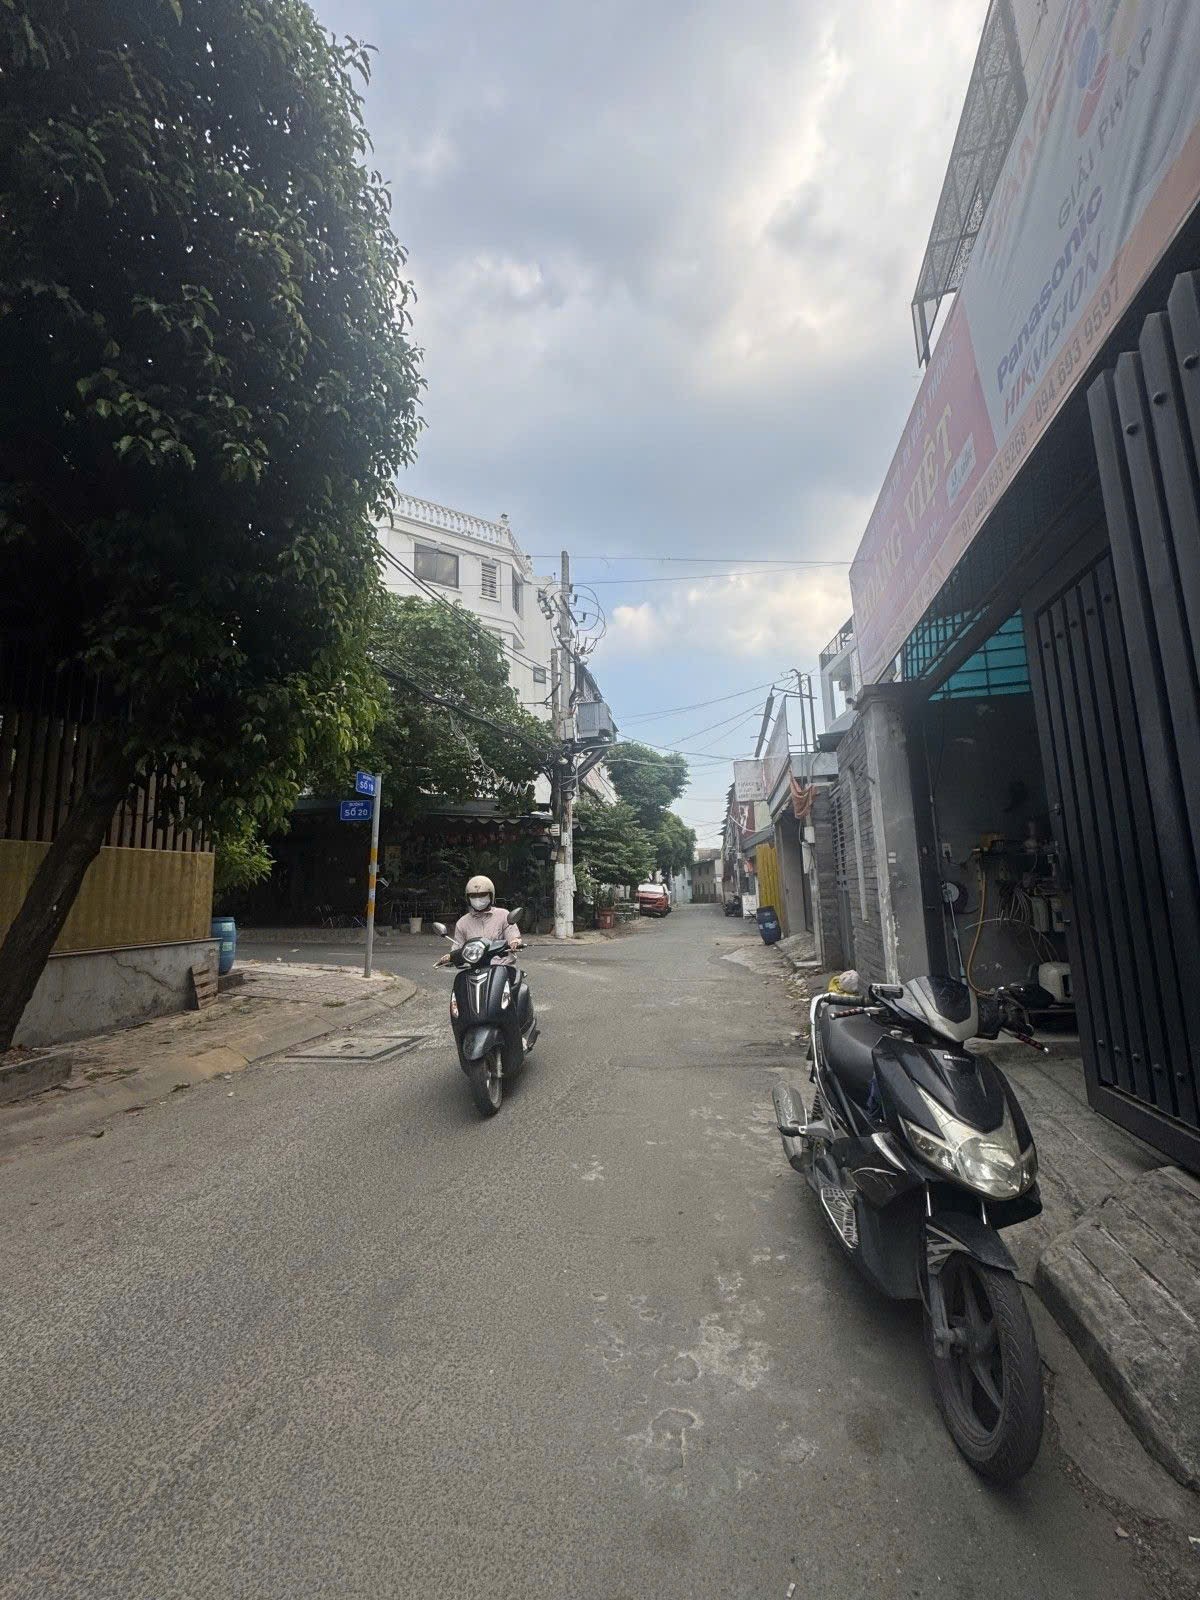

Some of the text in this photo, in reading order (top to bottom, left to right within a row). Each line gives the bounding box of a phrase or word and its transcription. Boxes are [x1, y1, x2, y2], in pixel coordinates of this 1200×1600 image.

[1057, 26, 1152, 229] GIẢI PHÁP
[997, 186, 1102, 391] Panasonic
[1004, 232, 1101, 425] HIKVISION
[1034, 385, 1058, 422] 094
[1057, 338, 1082, 391] 693
[1084, 269, 1122, 345] 9597
[903, 401, 952, 533] VIỆT
[344, 806, 368, 816] SỐ 20
